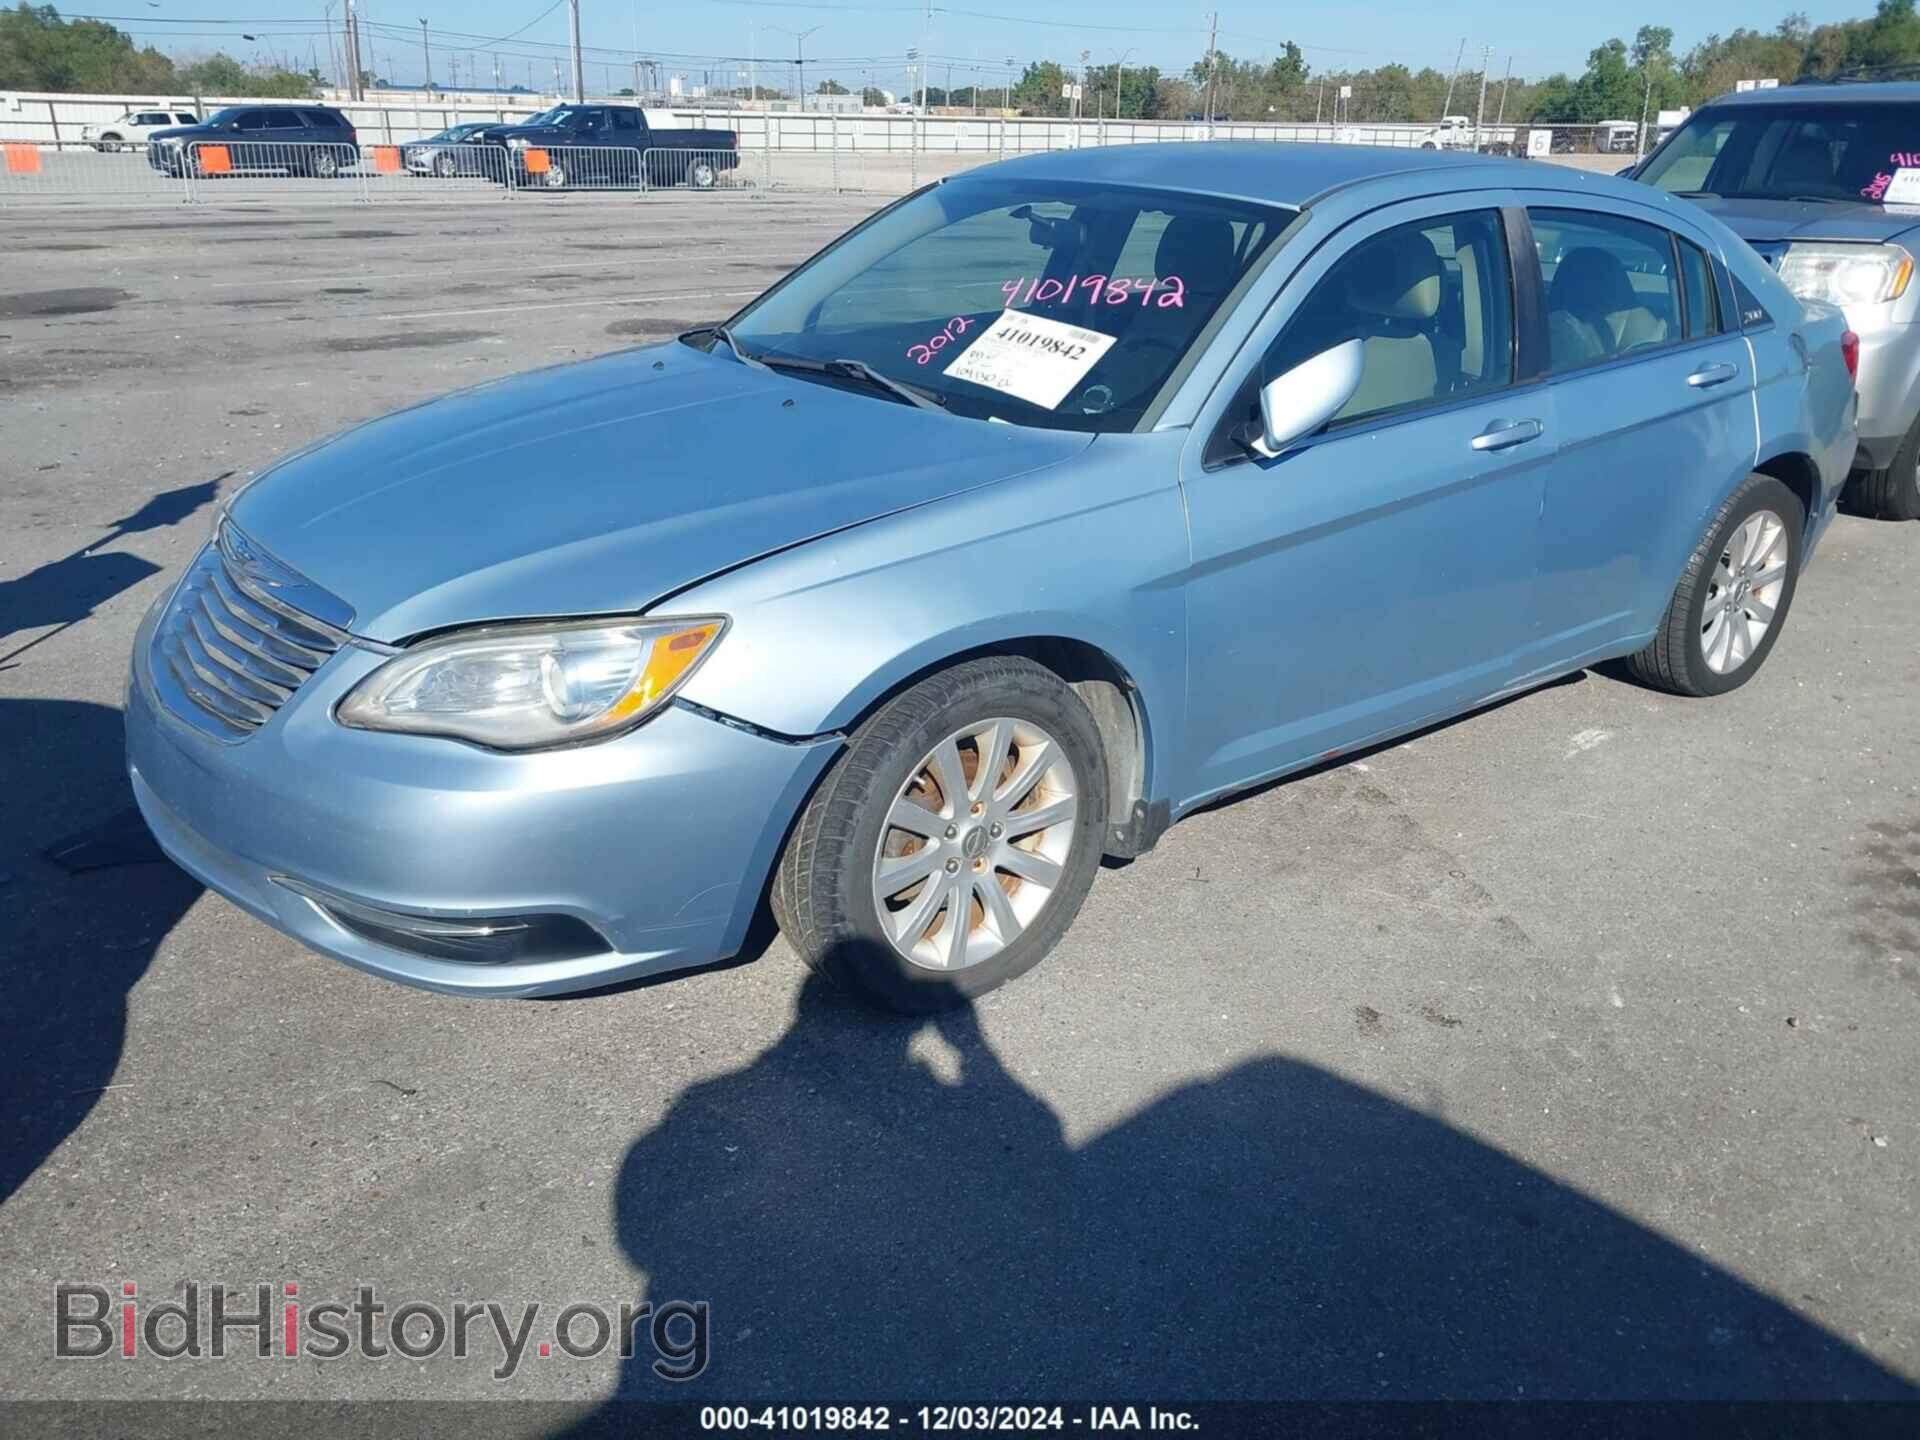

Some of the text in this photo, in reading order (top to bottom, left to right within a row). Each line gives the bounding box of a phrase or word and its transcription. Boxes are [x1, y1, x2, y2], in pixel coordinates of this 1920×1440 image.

[1535, 135, 1546, 151] 6
[1001, 275, 1186, 308] 41019842
[907, 316, 976, 365] 2012
[996, 326, 1087, 361] 41019842
